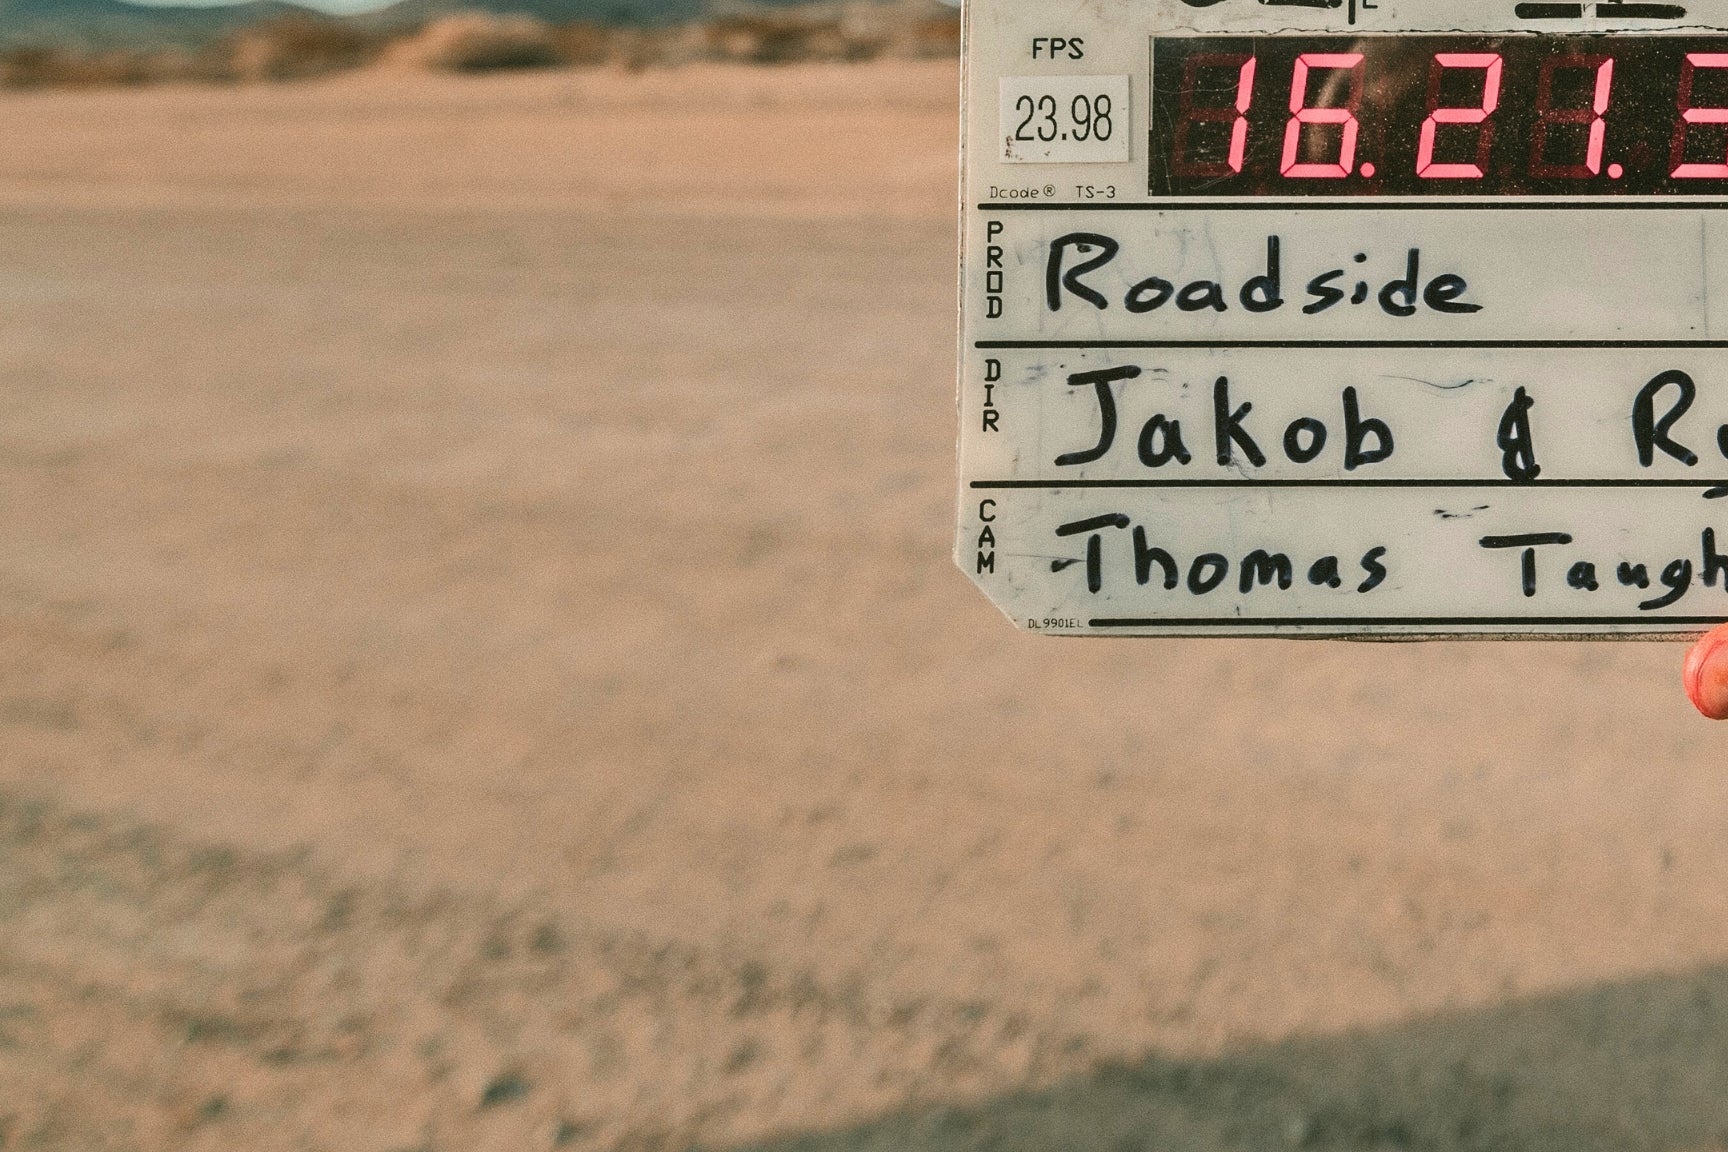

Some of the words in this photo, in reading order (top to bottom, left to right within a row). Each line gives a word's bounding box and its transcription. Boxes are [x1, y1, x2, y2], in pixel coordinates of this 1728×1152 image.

[1031, 37, 1084, 60] FPS
[1014, 93, 1113, 143] 23.98
[1075, 185, 1117, 199] TS-3
[985, 220, 1004, 319] PROD
[1045, 232, 1484, 317] Roadside
[982, 359, 1001, 433] DIR
[1055, 365, 1395, 471] Jakob
[976, 499, 998, 574] CAM
[1051, 512, 1388, 595] Thomas
